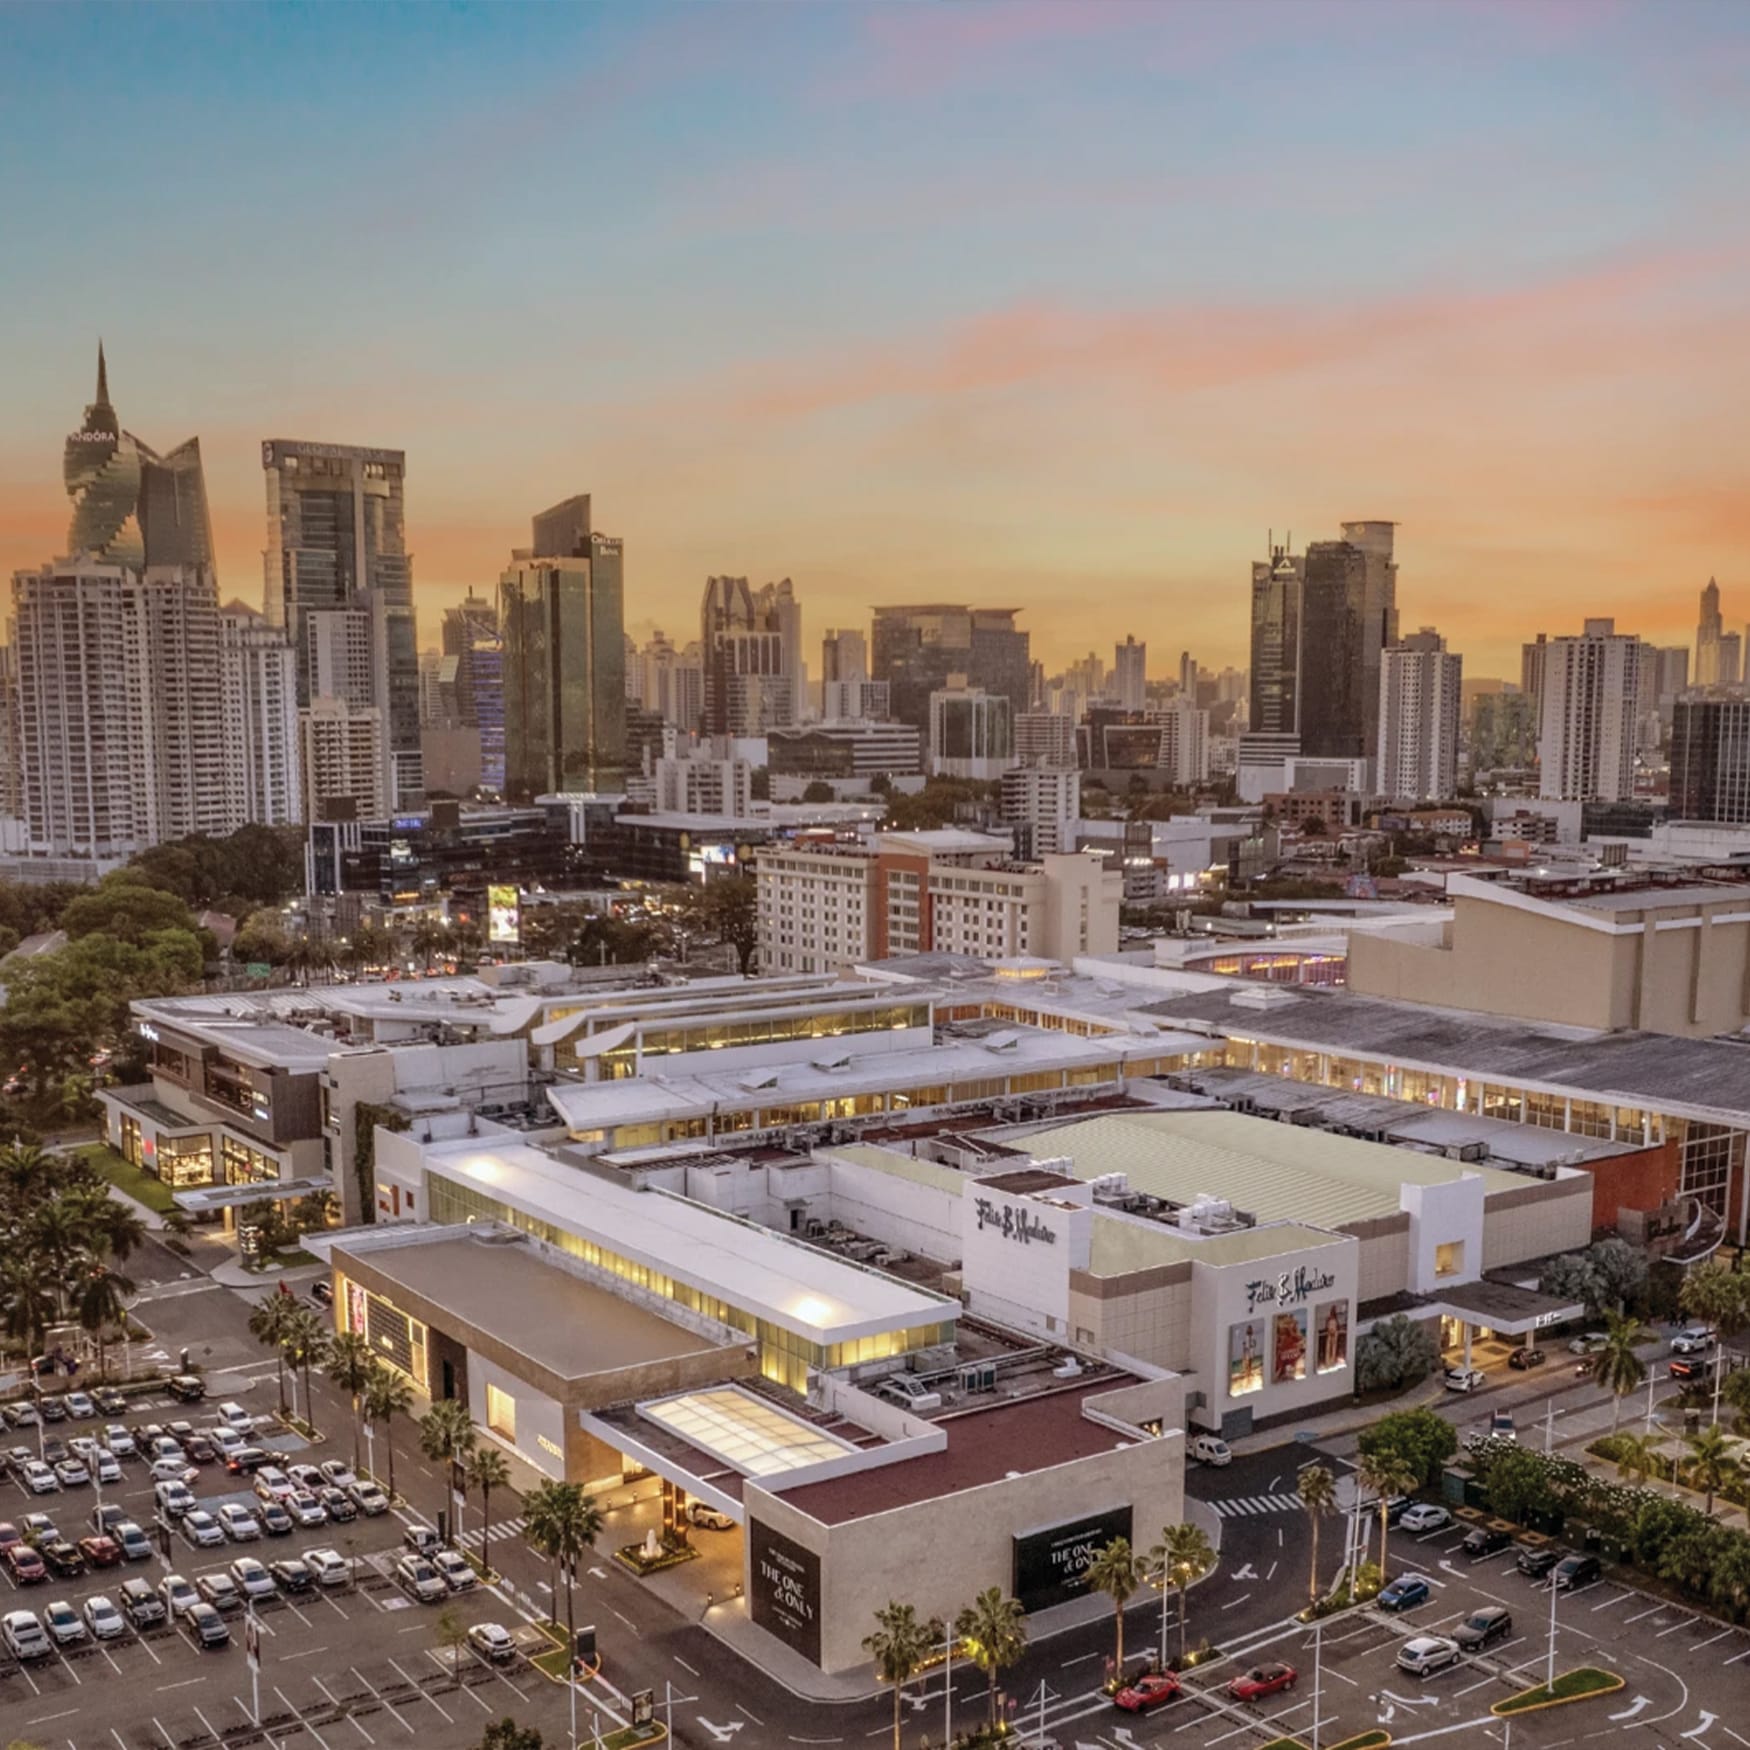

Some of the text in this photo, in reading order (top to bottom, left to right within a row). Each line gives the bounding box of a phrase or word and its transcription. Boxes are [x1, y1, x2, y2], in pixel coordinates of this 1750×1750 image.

[1051, 1547, 1072, 1564] THE
[760, 1559, 781, 1585] THE
[782, 1575, 804, 1600] ONE
[773, 1586, 785, 1603] &
[785, 1592, 814, 1620] ONLY
